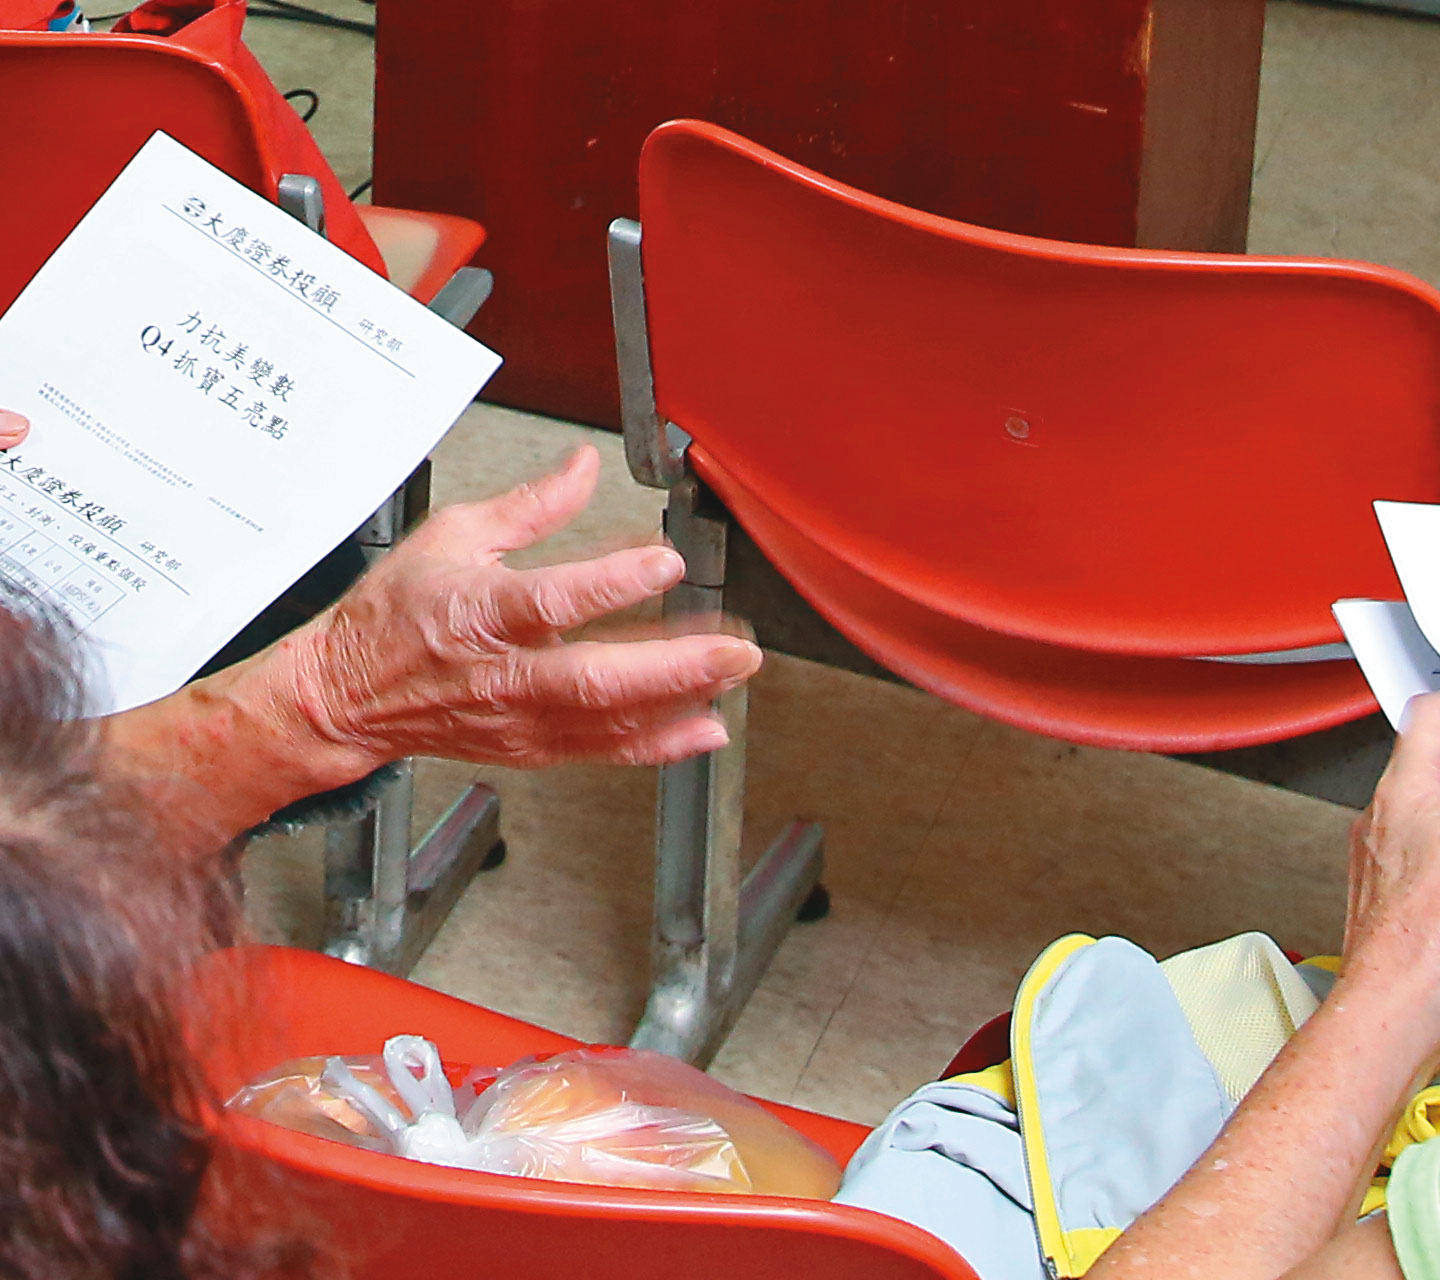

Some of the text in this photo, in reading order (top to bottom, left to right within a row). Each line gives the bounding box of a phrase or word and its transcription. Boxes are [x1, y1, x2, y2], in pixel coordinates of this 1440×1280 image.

[202, 211, 405, 354] 大慶證券投顧 研究部
[139, 324, 175, 357] Q4
[173, 349, 290, 441] 抓寶五亮點
[176, 311, 296, 403] 力抗美變數
[2, 452, 185, 574] 大慶證券投顧 研究部
